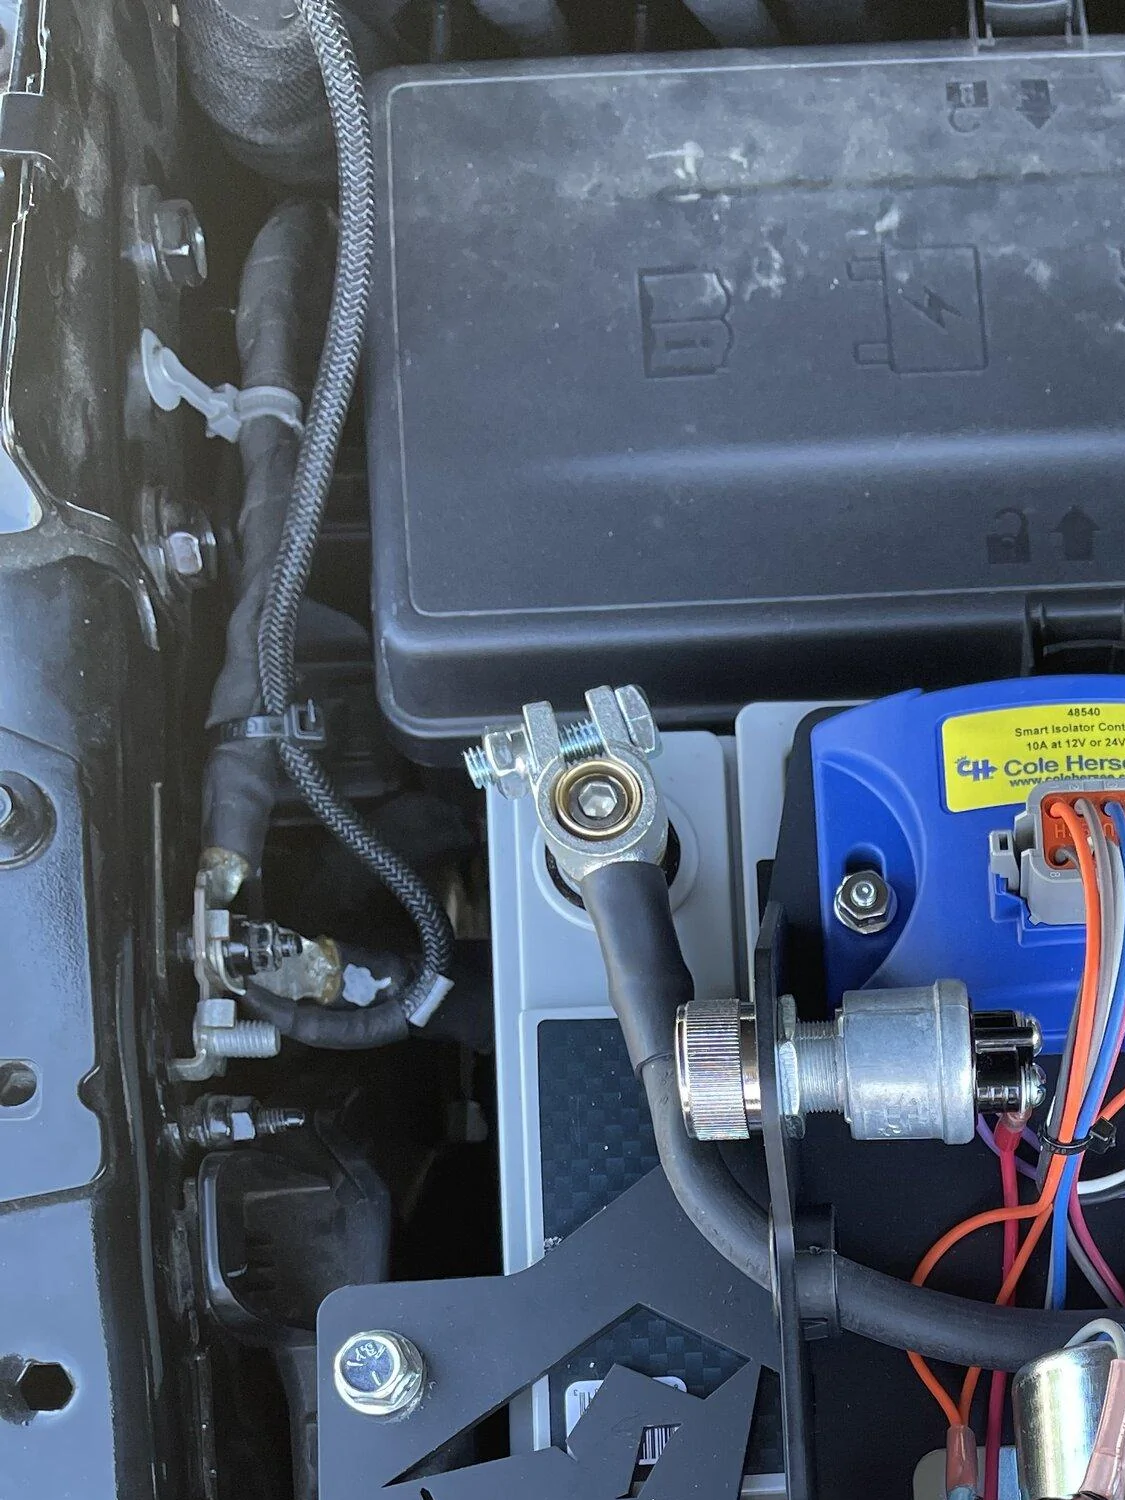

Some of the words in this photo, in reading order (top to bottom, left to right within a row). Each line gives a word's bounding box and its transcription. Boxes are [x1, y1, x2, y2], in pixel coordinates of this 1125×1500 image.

[1067, 707, 1101, 717] 48540
[1014, 726, 1049, 737] Smart
[1052, 723, 1095, 734] Isolator
[1027, 740, 1048, 751] 10A
[1051, 740, 1065, 749] at
[1066, 738, 1087, 748] 12V
[1089, 739, 1102, 748] or
[1105, 737, 1125, 748] 24V
[1004, 757, 1059, 776] Cole
